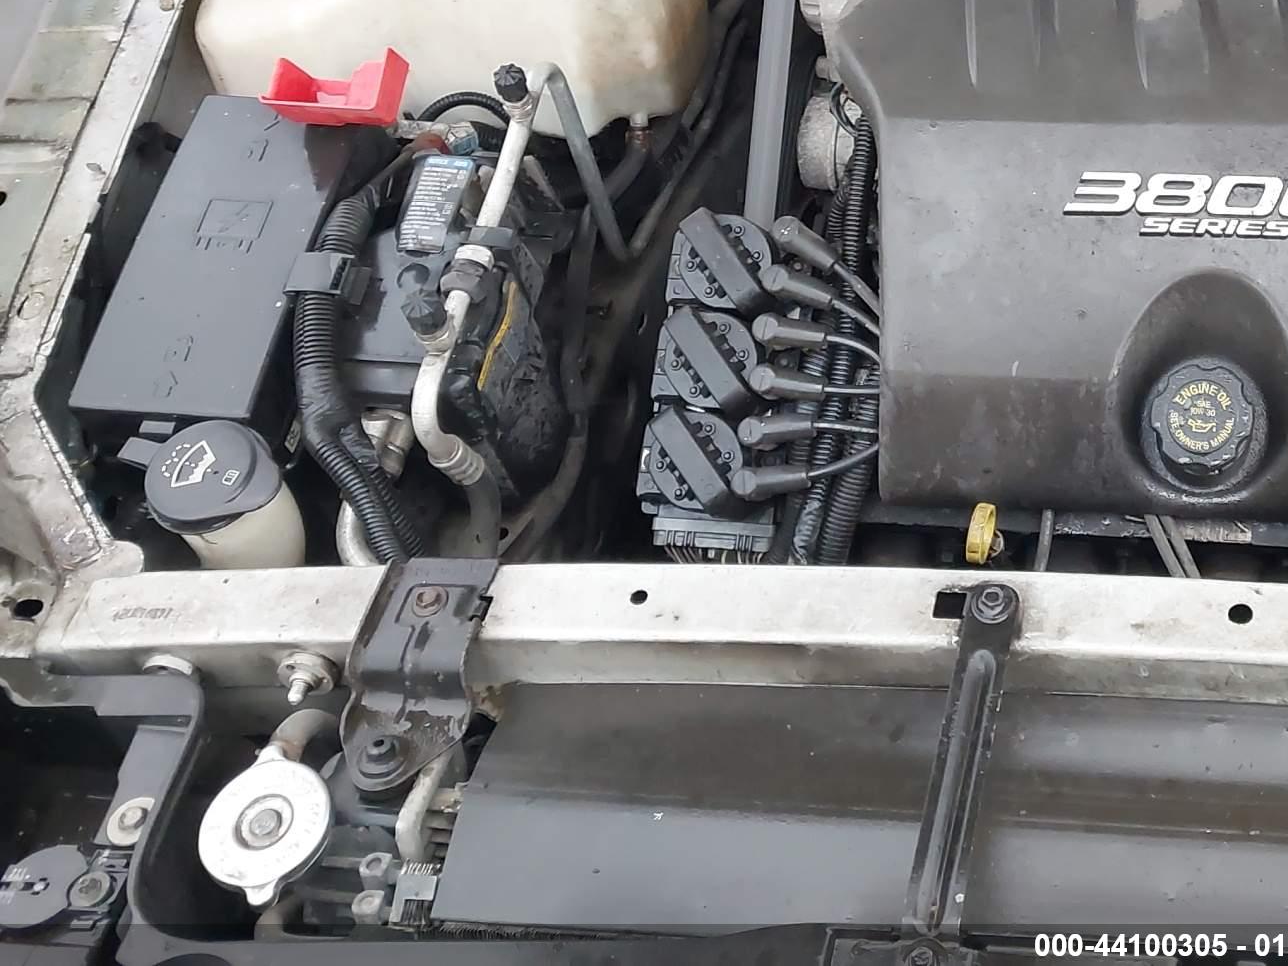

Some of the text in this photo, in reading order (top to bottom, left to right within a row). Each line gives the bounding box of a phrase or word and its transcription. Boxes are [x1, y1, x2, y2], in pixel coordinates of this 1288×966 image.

[1174, 382, 1232, 410] ENGINE OIL
[1196, 400, 1212, 408] SAE
[1169, 412, 1235, 450] SEE OWNER'S MANUAL
